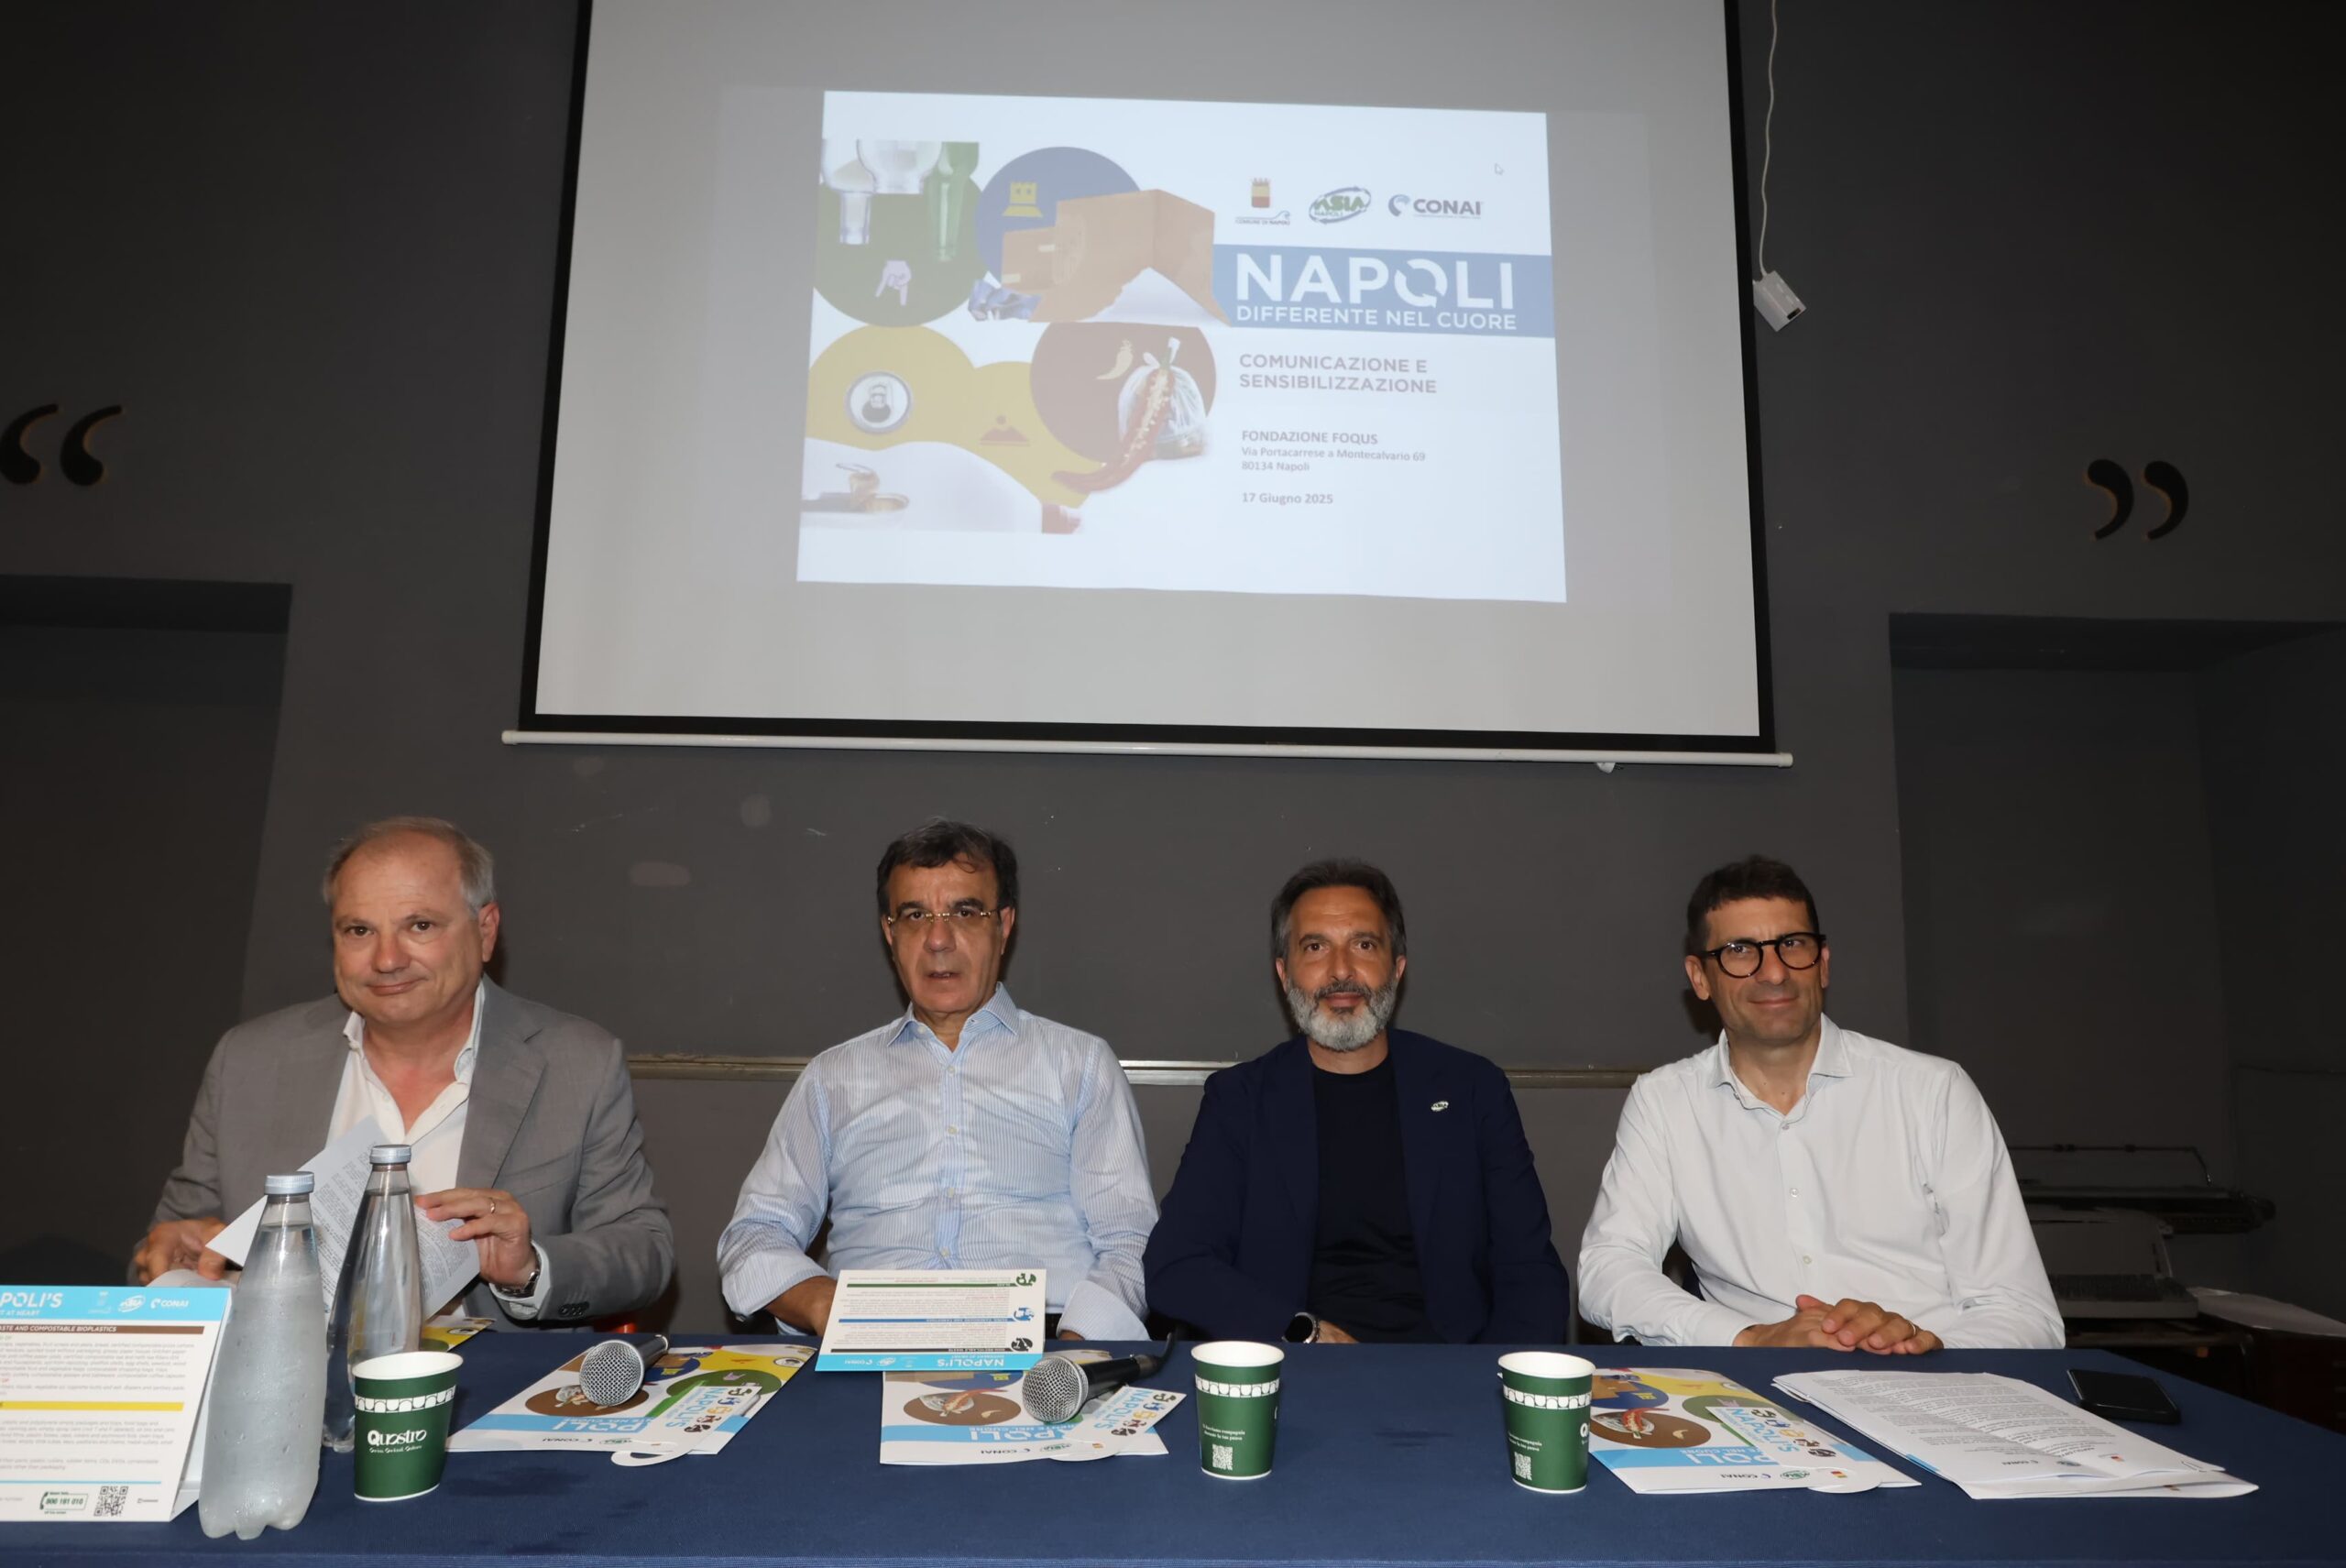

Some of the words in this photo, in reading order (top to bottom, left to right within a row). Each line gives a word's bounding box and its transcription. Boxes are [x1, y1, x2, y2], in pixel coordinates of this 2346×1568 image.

[1313, 195, 1365, 212] ASIA
[1413, 198, 1482, 216] CONAI
[1236, 252, 1514, 311] NAPOLI
[1237, 305, 1378, 325] DIFFERENTE
[1386, 311, 1430, 327] NEL
[1437, 312, 1517, 330] CUORE
[1239, 354, 1409, 373] COMUNICAZIONE
[1416, 359, 1428, 373] E
[1239, 374, 1437, 394] SENSIBILIZZAZIONE
[1242, 431, 1329, 444] FONDAZIONE
[1332, 432, 1378, 445] FOQUS
[1242, 447, 1258, 457] Via
[1260, 446, 1326, 458] Portacarrese
[1328, 451, 1334, 459] a
[1337, 449, 1410, 461] Montecalvario
[1412, 452, 1426, 462] 69
[1242, 461, 1274, 471] 80134
[1277, 462, 1310, 473] Napoli
[1242, 492, 1256, 503] 17
[1259, 493, 1302, 506] Giugno
[1304, 493, 1334, 504] 2025
[552, 1421, 642, 1431] POLI
[1685, 1453, 1774, 1464] POLI
